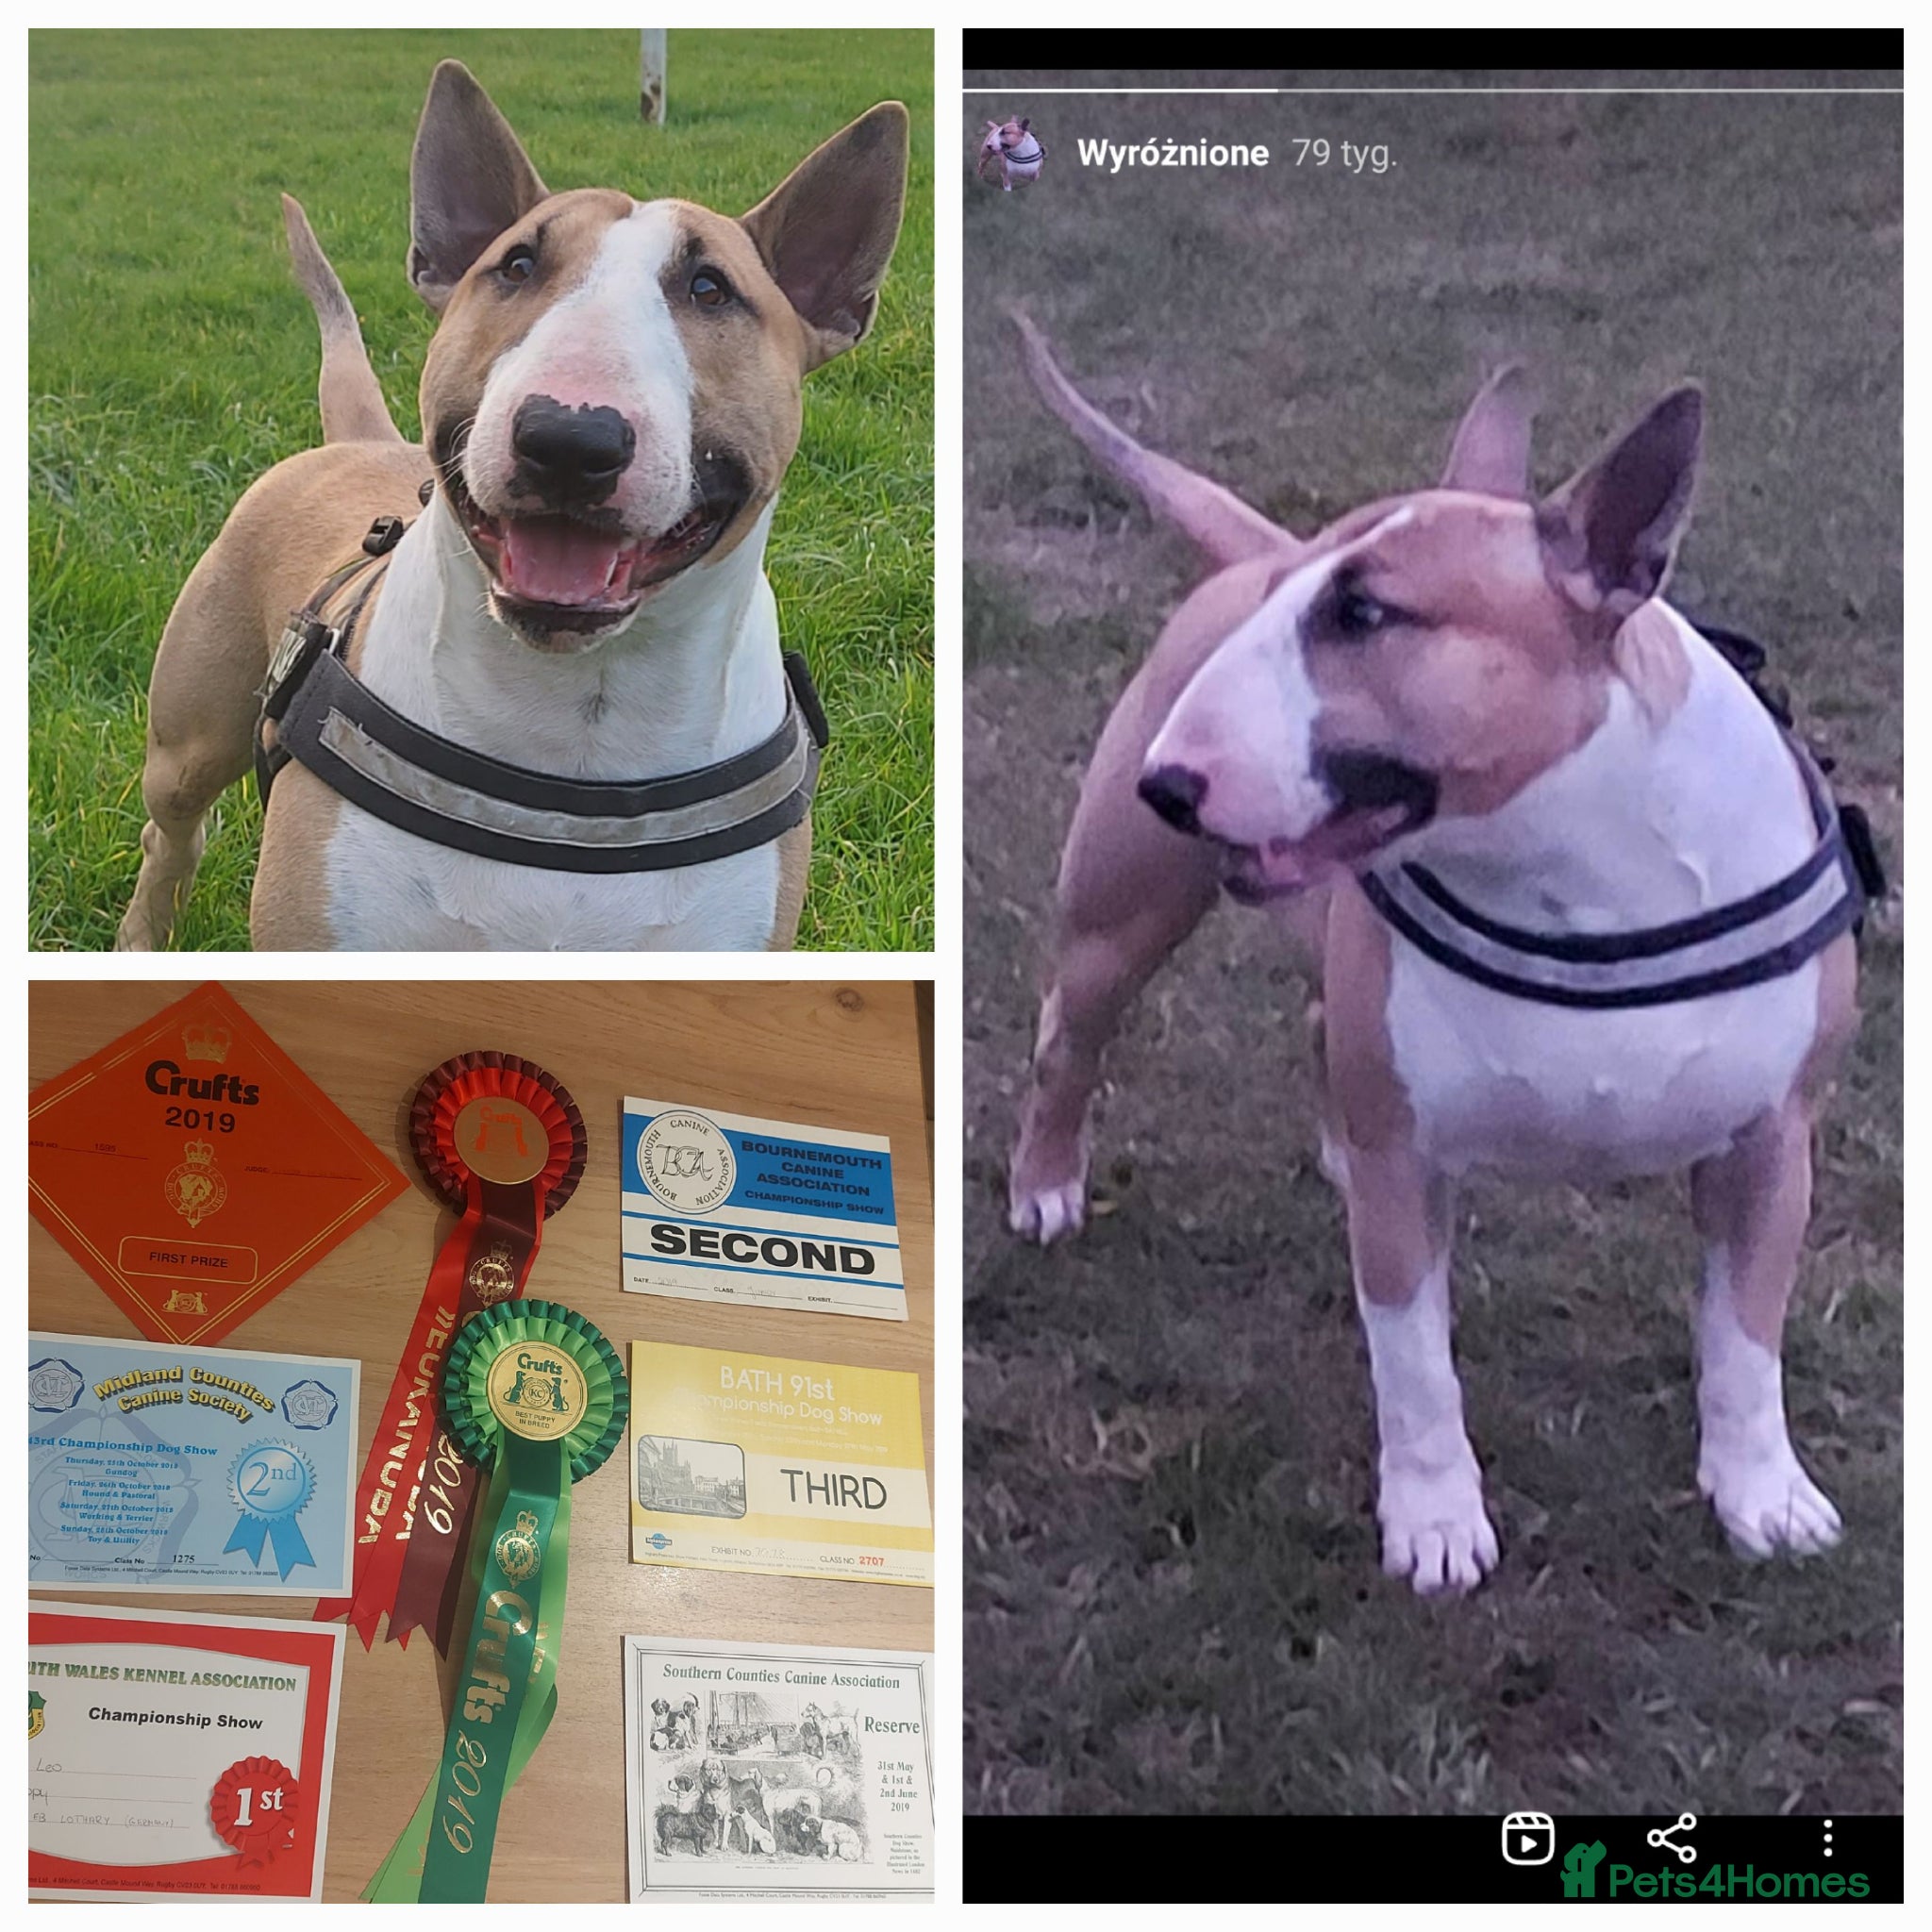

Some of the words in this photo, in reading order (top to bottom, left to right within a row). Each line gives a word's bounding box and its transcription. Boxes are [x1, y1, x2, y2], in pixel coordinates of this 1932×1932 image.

[145, 1060, 260, 1107] Crufts
[165, 1107, 236, 1134] 2019
[671, 1120, 709, 1136] CANINE
[644, 1129, 677, 1201] BOURNEMOUTH
[741, 1140, 882, 1170] BOURNEMOUTH
[695, 1148, 729, 1206] ASSOCIATION
[781, 1161, 844, 1179] CANINE
[757, 1173, 870, 1196] ASSOCIATION
[744, 1190, 843, 1209] CHAMPIONSHIP
[846, 1203, 884, 1215] SHOW
[651, 1224, 875, 1275] SECOND
[149, 1251, 188, 1265] FIRST
[191, 1255, 228, 1269] PRIZE
[92, 1365, 182, 1402] Midland
[189, 1366, 276, 1414] Counties
[720, 1365, 783, 1395] BATH
[790, 1374, 835, 1402] 91st
[118, 1388, 184, 1413] Canine
[189, 1387, 254, 1424] Society
[799, 1402, 835, 1424] Dog
[839, 1407, 883, 1426] Show
[515, 1410, 533, 1419] BEST
[533, 1414, 556, 1424] PUPPY
[527, 1420, 550, 1429] BREED
[58, 1437, 153, 1454] Championship
[157, 1443, 180, 1456] Dog
[184, 1444, 218, 1457] Show
[106, 1468, 138, 1478] Gundog
[127, 1459, 158, 1468] October
[119, 1481, 151, 1491] October
[246, 1461, 298, 1497] 2nd
[425, 1430, 463, 1535] 2019
[780, 1468, 888, 1509] THIRD
[82, 1490, 110, 1498] Hound
[122, 1491, 156, 1500] Pastoral
[79, 1512, 114, 1522] Working
[122, 1504, 154, 1512] October
[88, 1535, 103, 1544] Toy
[173, 1554, 195, 1564] 1275
[711, 1546, 738, 1556] EXHIBIT
[820, 1556, 842, 1564] CLASS
[859, 1556, 885, 1567] 2707
[463, 1591, 534, 1724] Crufts
[64, 1663, 120, 1680] WALES
[123, 1667, 187, 1686] KENNEL
[191, 1672, 297, 1692] ASSOCIATION
[662, 1663, 722, 1681] Southern
[726, 1667, 780, 1684] Counties
[785, 1670, 827, 1686] Canine
[831, 1673, 900, 1690] Association
[89, 1706, 211, 1729] Championship
[217, 1713, 263, 1730] Show
[864, 1715, 921, 1734] Reserve
[36, 1757, 62, 1773] Leo
[877, 1760, 894, 1771] 31st
[897, 1761, 914, 1773] May
[881, 1774, 889, 1784] &
[891, 1774, 904, 1784] 1st
[906, 1775, 913, 1785] &
[442, 1729, 487, 1855] 2019
[879, 1788, 895, 1798] 2nd
[897, 1789, 918, 1798] June
[233, 1786, 285, 1827] 1st
[891, 1802, 910, 1812] 2019
